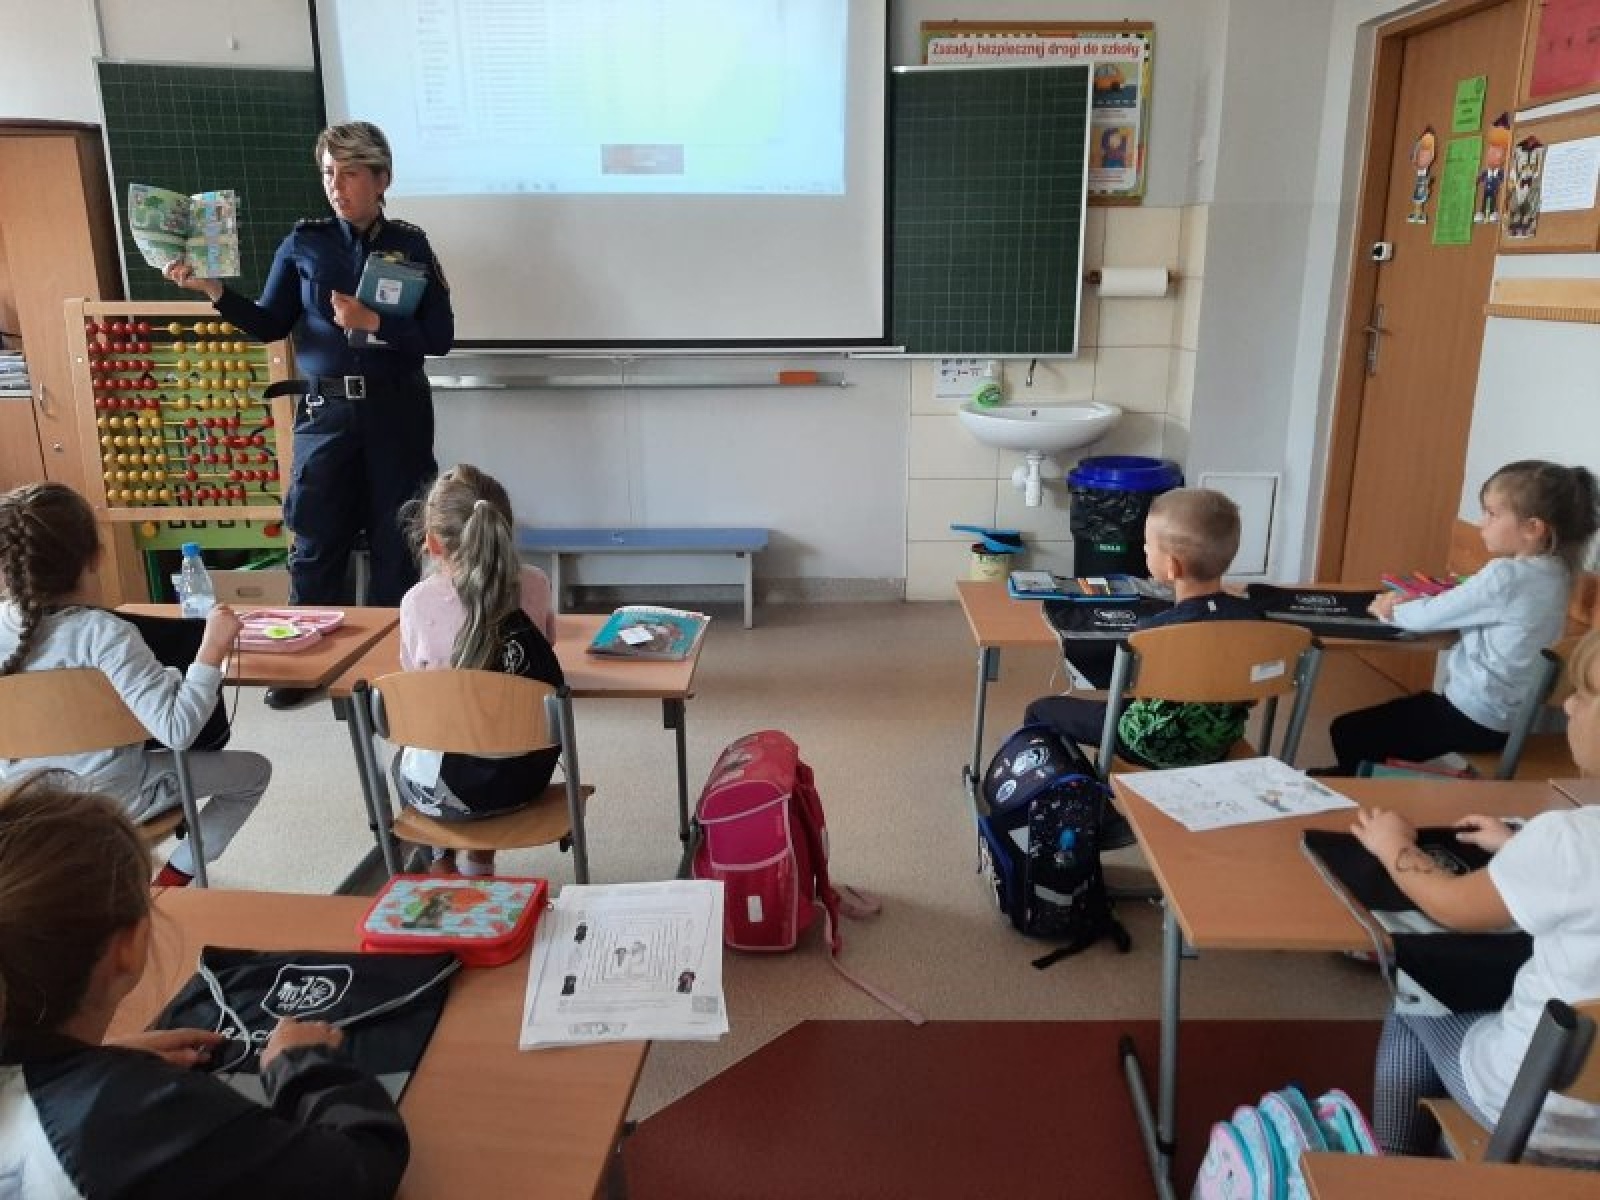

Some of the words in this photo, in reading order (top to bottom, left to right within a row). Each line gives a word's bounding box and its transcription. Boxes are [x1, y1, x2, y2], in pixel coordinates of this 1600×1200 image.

[933, 42, 973, 58] Zasady
[977, 42, 1044, 58] bezpiecznej
[1049, 42, 1080, 58] drogi
[1083, 42, 1099, 54] do
